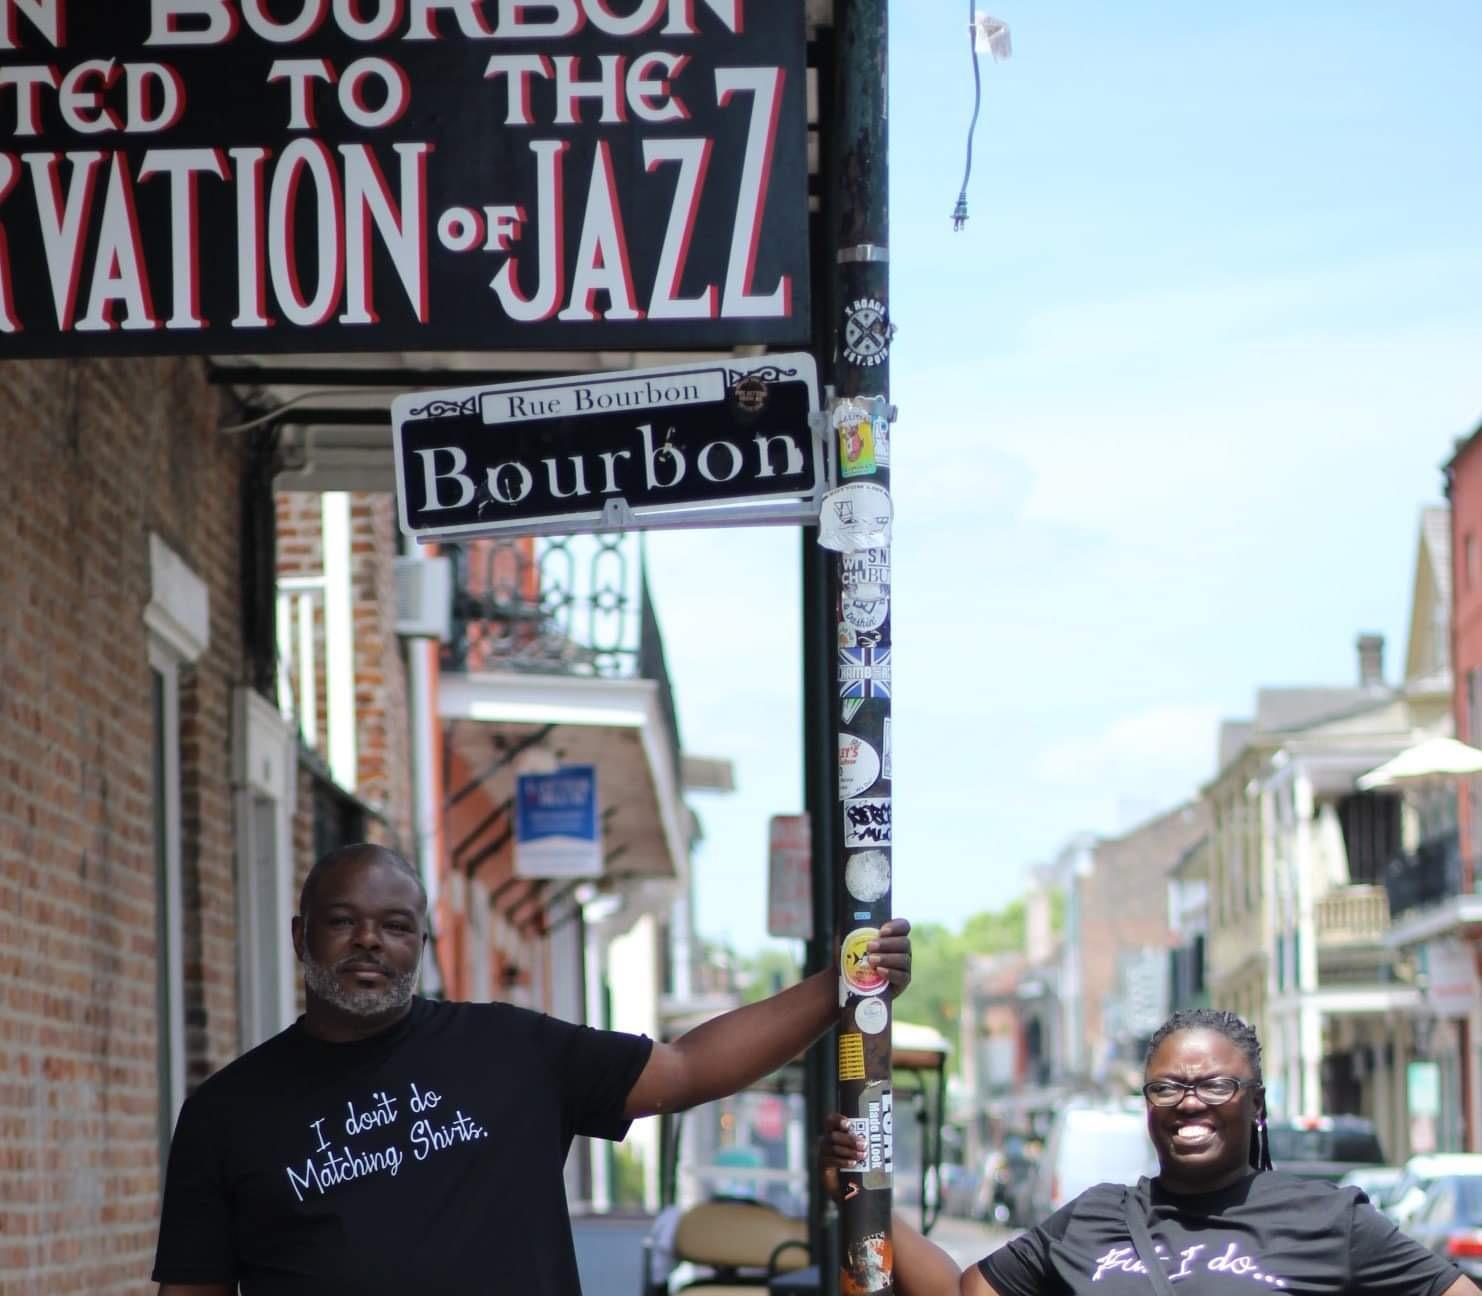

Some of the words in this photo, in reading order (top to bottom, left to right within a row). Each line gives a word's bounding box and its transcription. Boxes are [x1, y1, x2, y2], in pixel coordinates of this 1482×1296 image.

[266, 57, 412, 130] TO
[483, 51, 691, 126] THE
[438, 204, 528, 253] OF
[490, 66, 792, 322] JAZZ
[508, 396, 561, 417] Rue
[574, 381, 700, 411] Bourbon
[411, 424, 804, 513] Bourbon
[286, 1146, 403, 1202] Matching
[410, 1110, 489, 1160] Shirts.
[309, 1118, 331, 1153] I
[345, 1092, 398, 1135] don't
[410, 1082, 442, 1112] do
[1168, 1244, 1206, 1281] I
